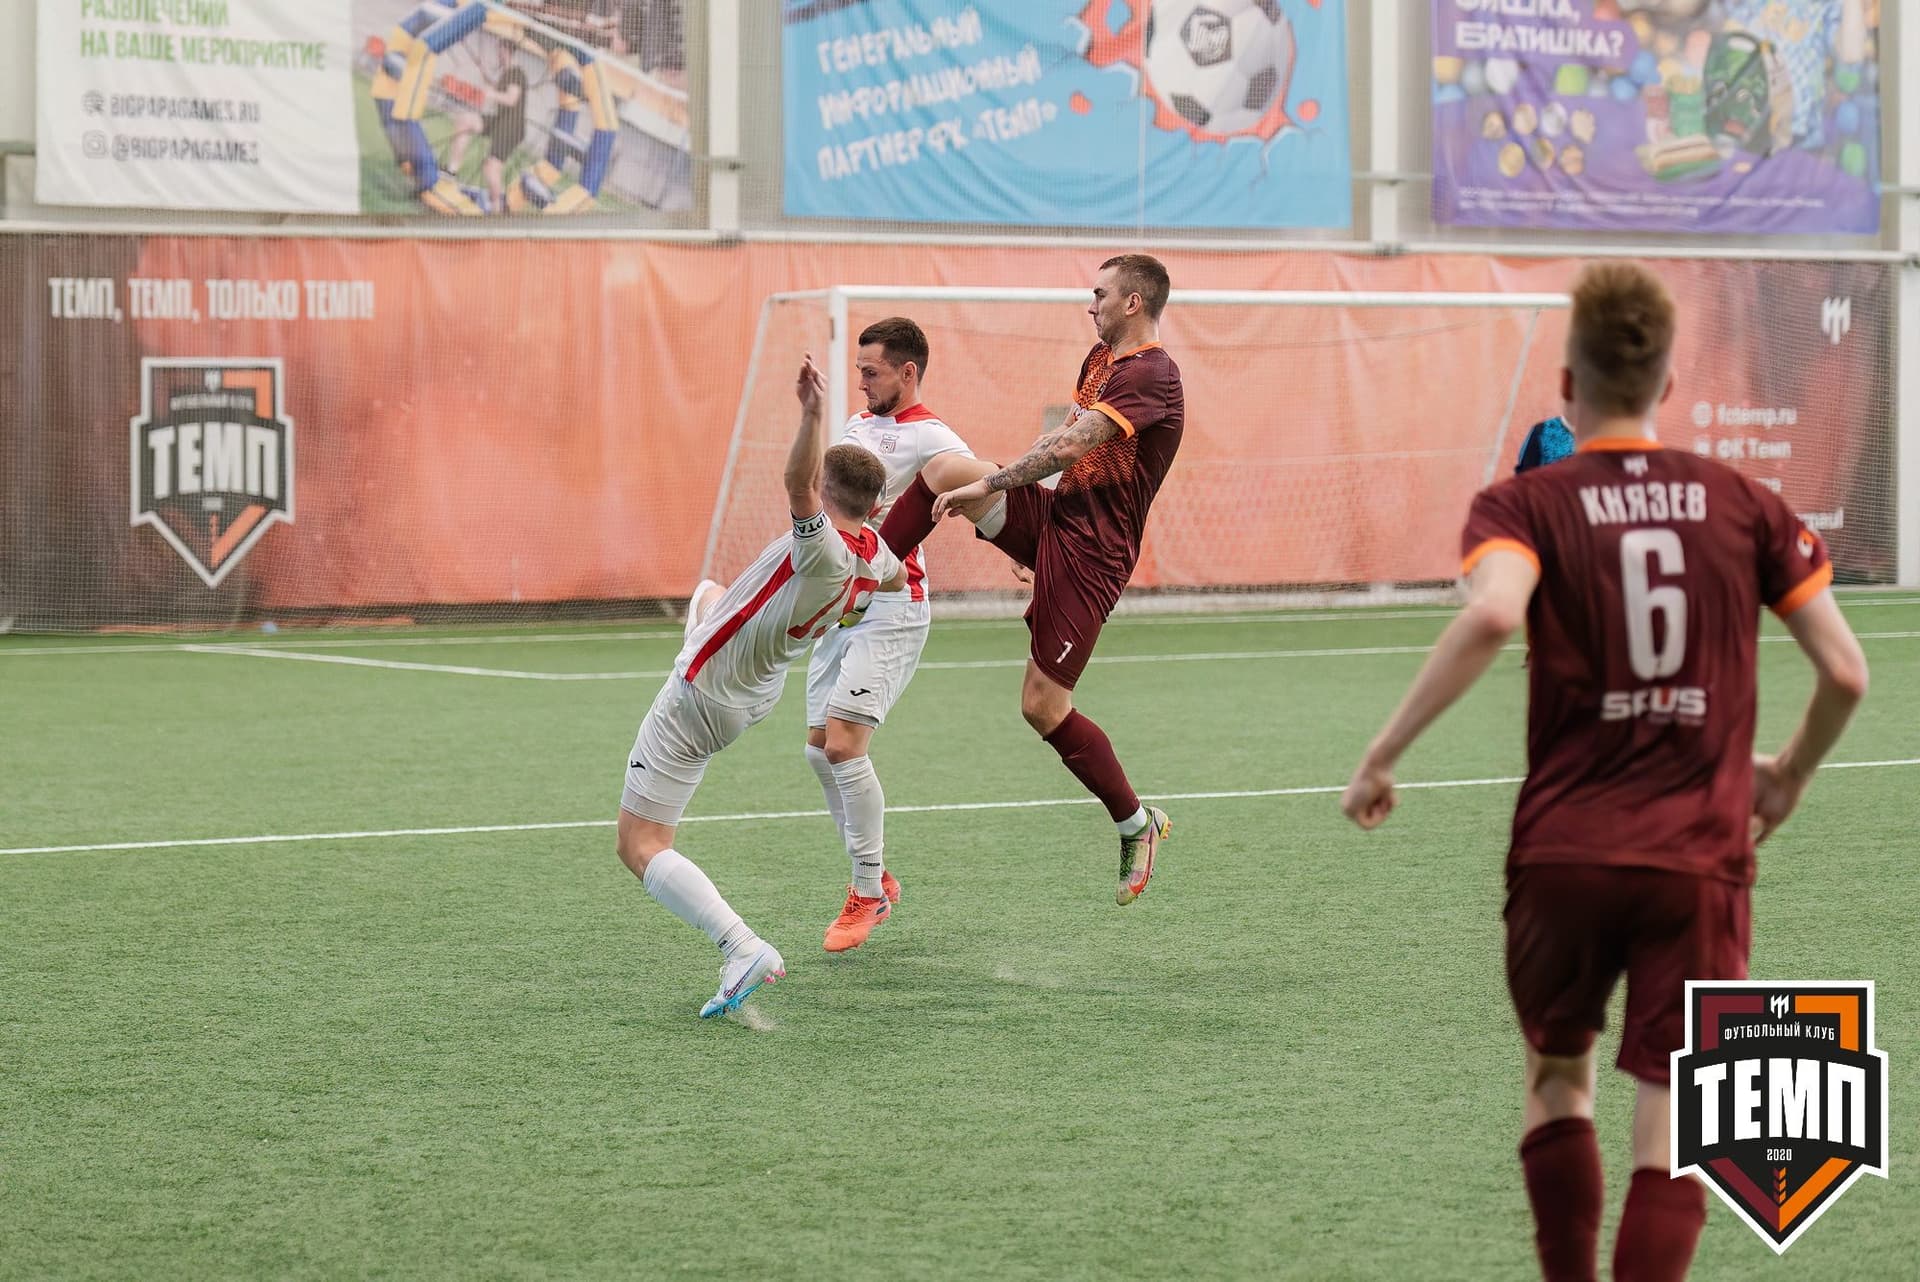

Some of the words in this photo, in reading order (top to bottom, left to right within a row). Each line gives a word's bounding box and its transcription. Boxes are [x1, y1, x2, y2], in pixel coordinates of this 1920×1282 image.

[81, 31, 108, 57] НА
[115, 32, 175, 61] ВАШЕ
[181, 37, 327, 70] МЕРОПРИЯТИЕ
[817, 7, 982, 73] ГЕНЕРАЛЬНЫЙ
[1455, 21, 1624, 57] БРАТИШКА?
[819, 42, 1041, 129] ИНФОРМАЦИОННЫЙ
[818, 128, 923, 180] ПАРТНЕР
[928, 118, 969, 153] ФК
[49, 277, 122, 322] ТЕМП,
[128, 279, 199, 322] ТЕМП,
[206, 280, 298, 320] ТОЛЬКО
[304, 281, 375, 319] ТЕМП!
[149, 421, 279, 500] ТЕМП
[1579, 482, 1708, 527] КНЯЗЕВ
[1620, 528, 1688, 681] 6
